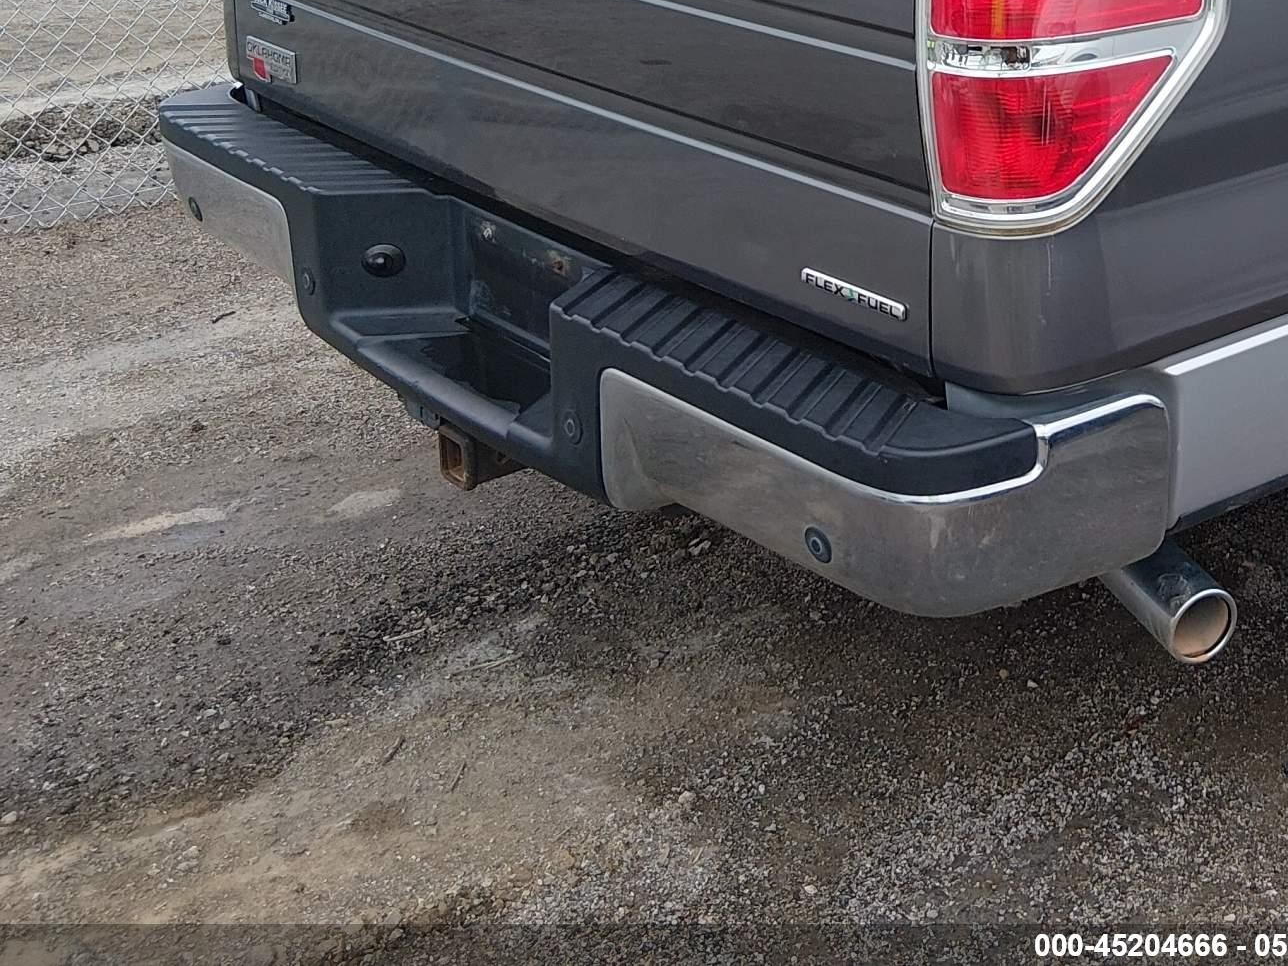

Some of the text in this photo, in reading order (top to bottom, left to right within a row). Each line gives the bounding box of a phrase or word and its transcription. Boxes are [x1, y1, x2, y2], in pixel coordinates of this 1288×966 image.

[247, 41, 291, 66] OKLAHOMA
[805, 272, 902, 321] FLEX FUEL
